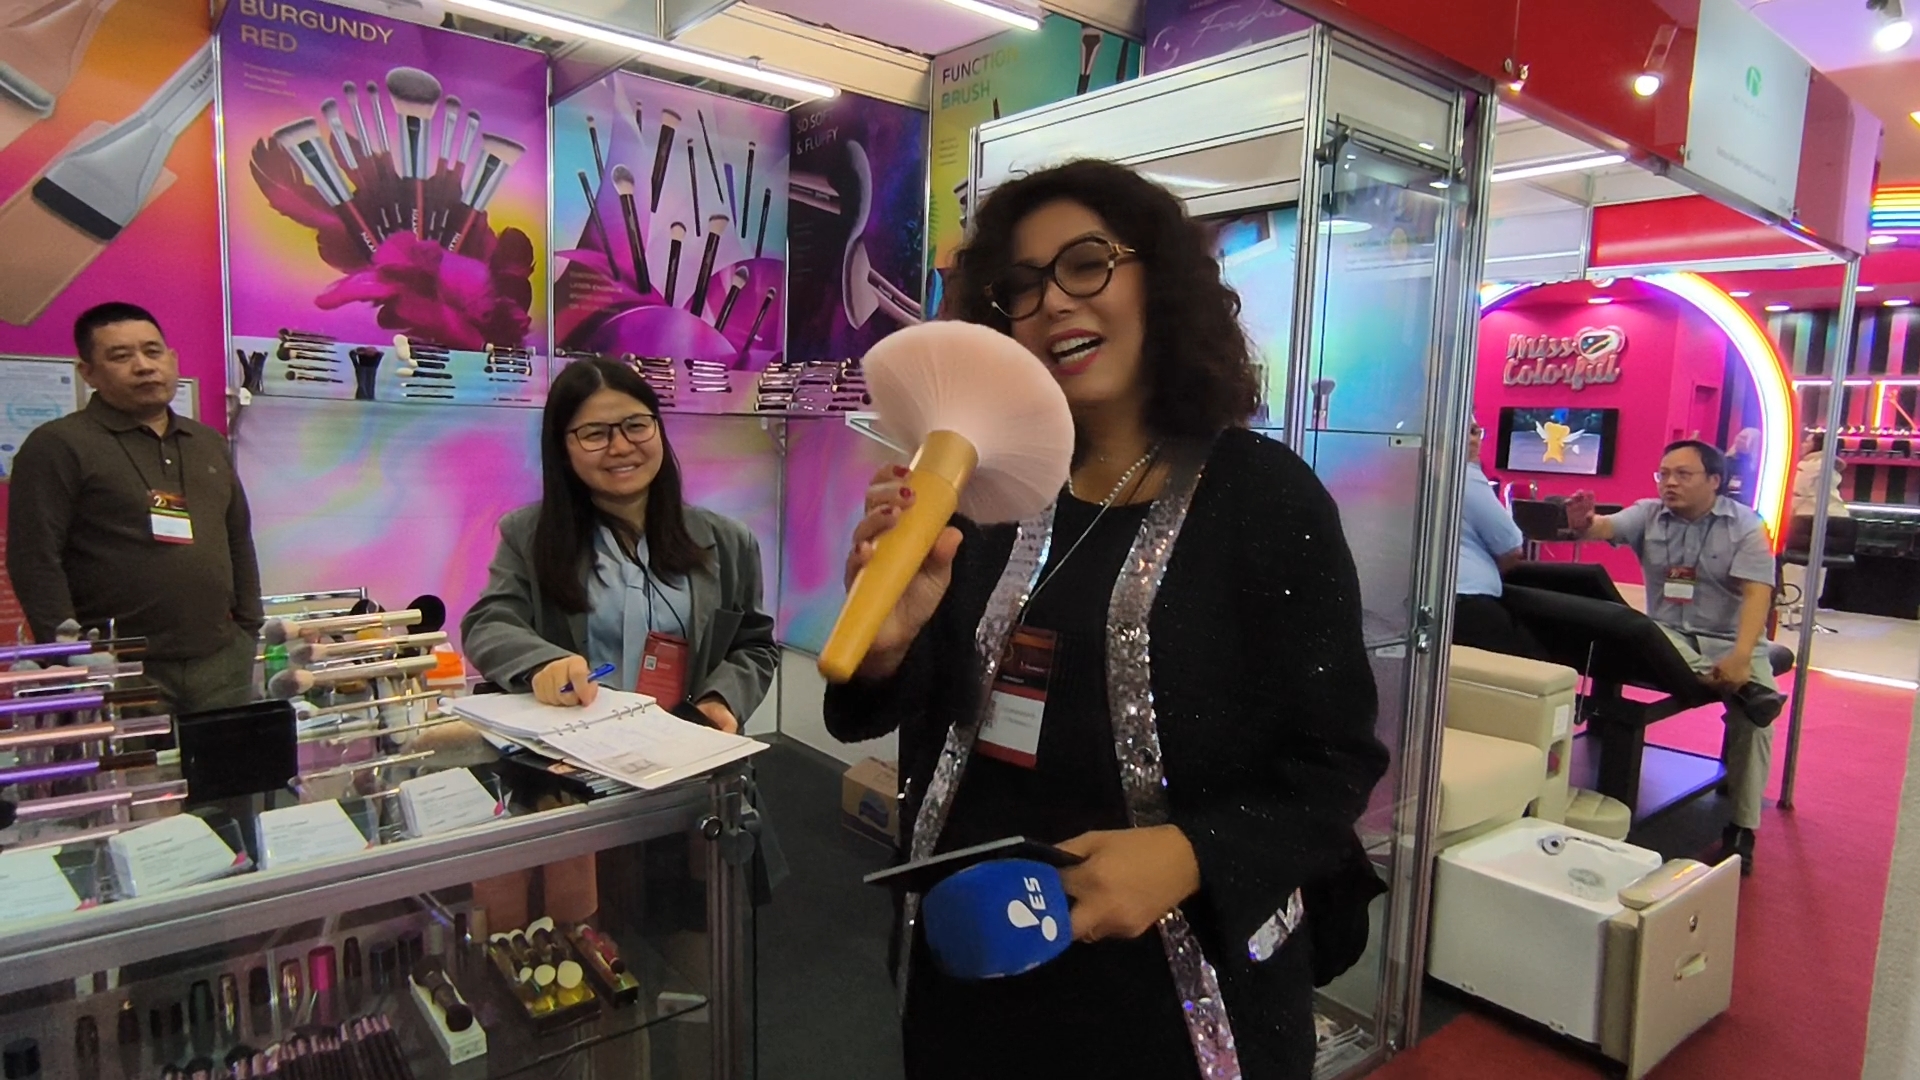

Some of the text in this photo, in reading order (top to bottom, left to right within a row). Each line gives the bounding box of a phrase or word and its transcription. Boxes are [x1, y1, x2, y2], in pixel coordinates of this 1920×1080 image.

[239, 0, 394, 45] BURGUNDY
[240, 23, 299, 53] RED
[942, 46, 1019, 85] FUNCTION
[941, 80, 991, 110] BRUSH
[1506, 333, 1575, 360] Miss
[1502, 354, 1621, 391] Colorful
[1023, 876, 1047, 910] ES
